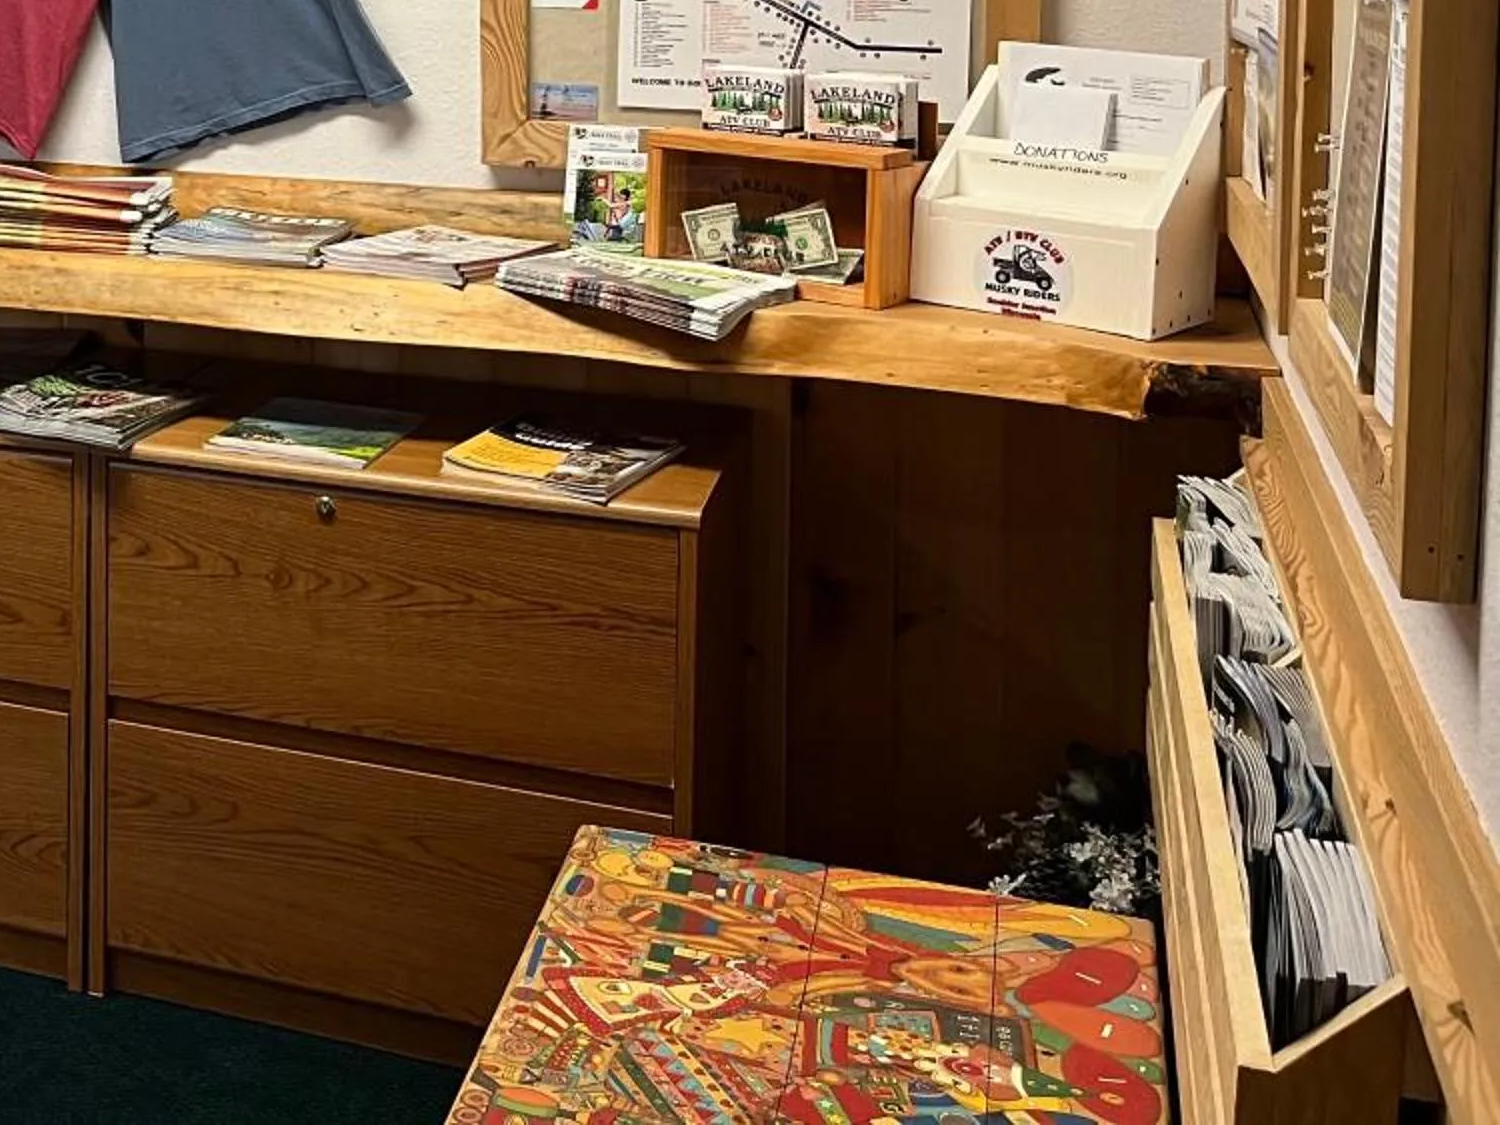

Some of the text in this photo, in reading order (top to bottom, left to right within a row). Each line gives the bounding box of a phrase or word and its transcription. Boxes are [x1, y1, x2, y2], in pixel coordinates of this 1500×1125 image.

[704, 75, 785, 95] LAKELAND
[810, 86, 896, 109] LAKELAND
[719, 114, 741, 125] ATV
[827, 125, 850, 137] ATV
[1013, 142, 1109, 164] DONATIONS
[984, 235, 1003, 256] ATV
[1040, 238, 1065, 264] CLUB
[985, 282, 1061, 302] MUSKY RIDERS
